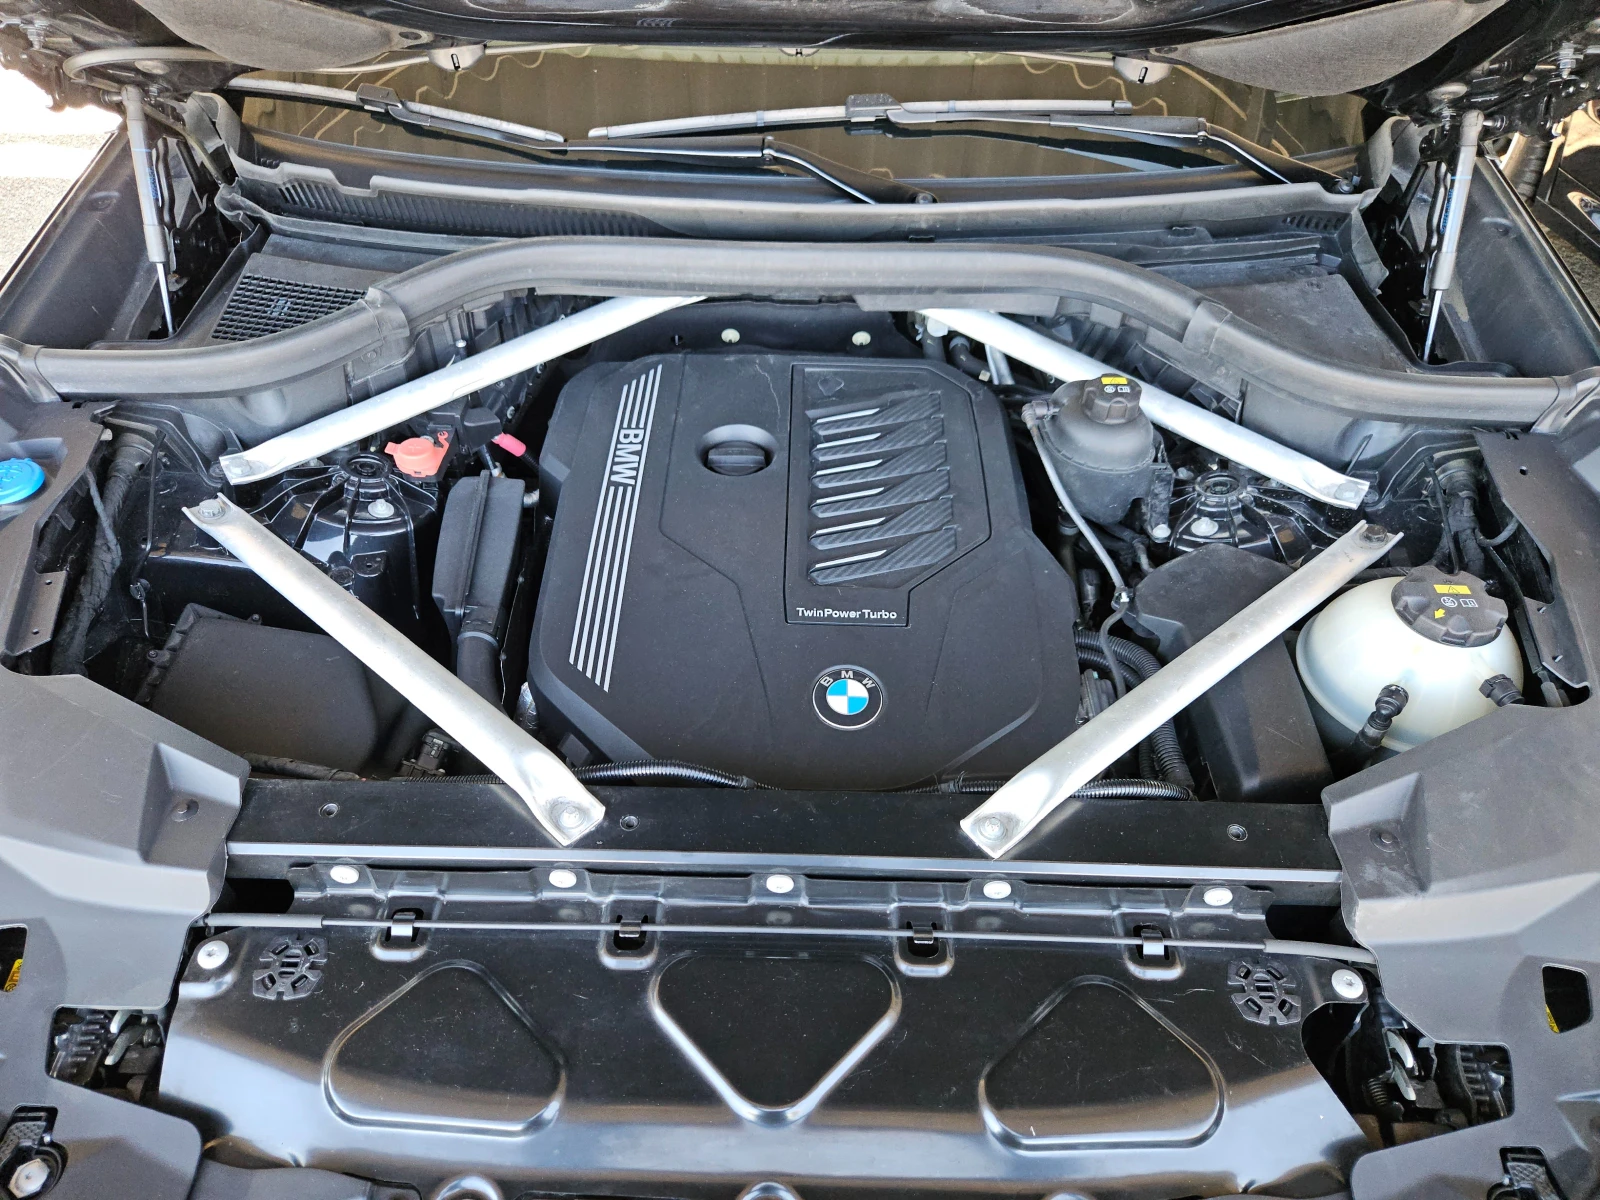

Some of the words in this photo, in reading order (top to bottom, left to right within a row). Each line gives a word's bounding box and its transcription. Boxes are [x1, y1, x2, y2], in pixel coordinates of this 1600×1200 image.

[610, 429, 645, 485] BMW
[796, 607, 861, 619] TwinPower
[862, 609, 898, 619] Turbo
[820, 670, 876, 689] BMW
